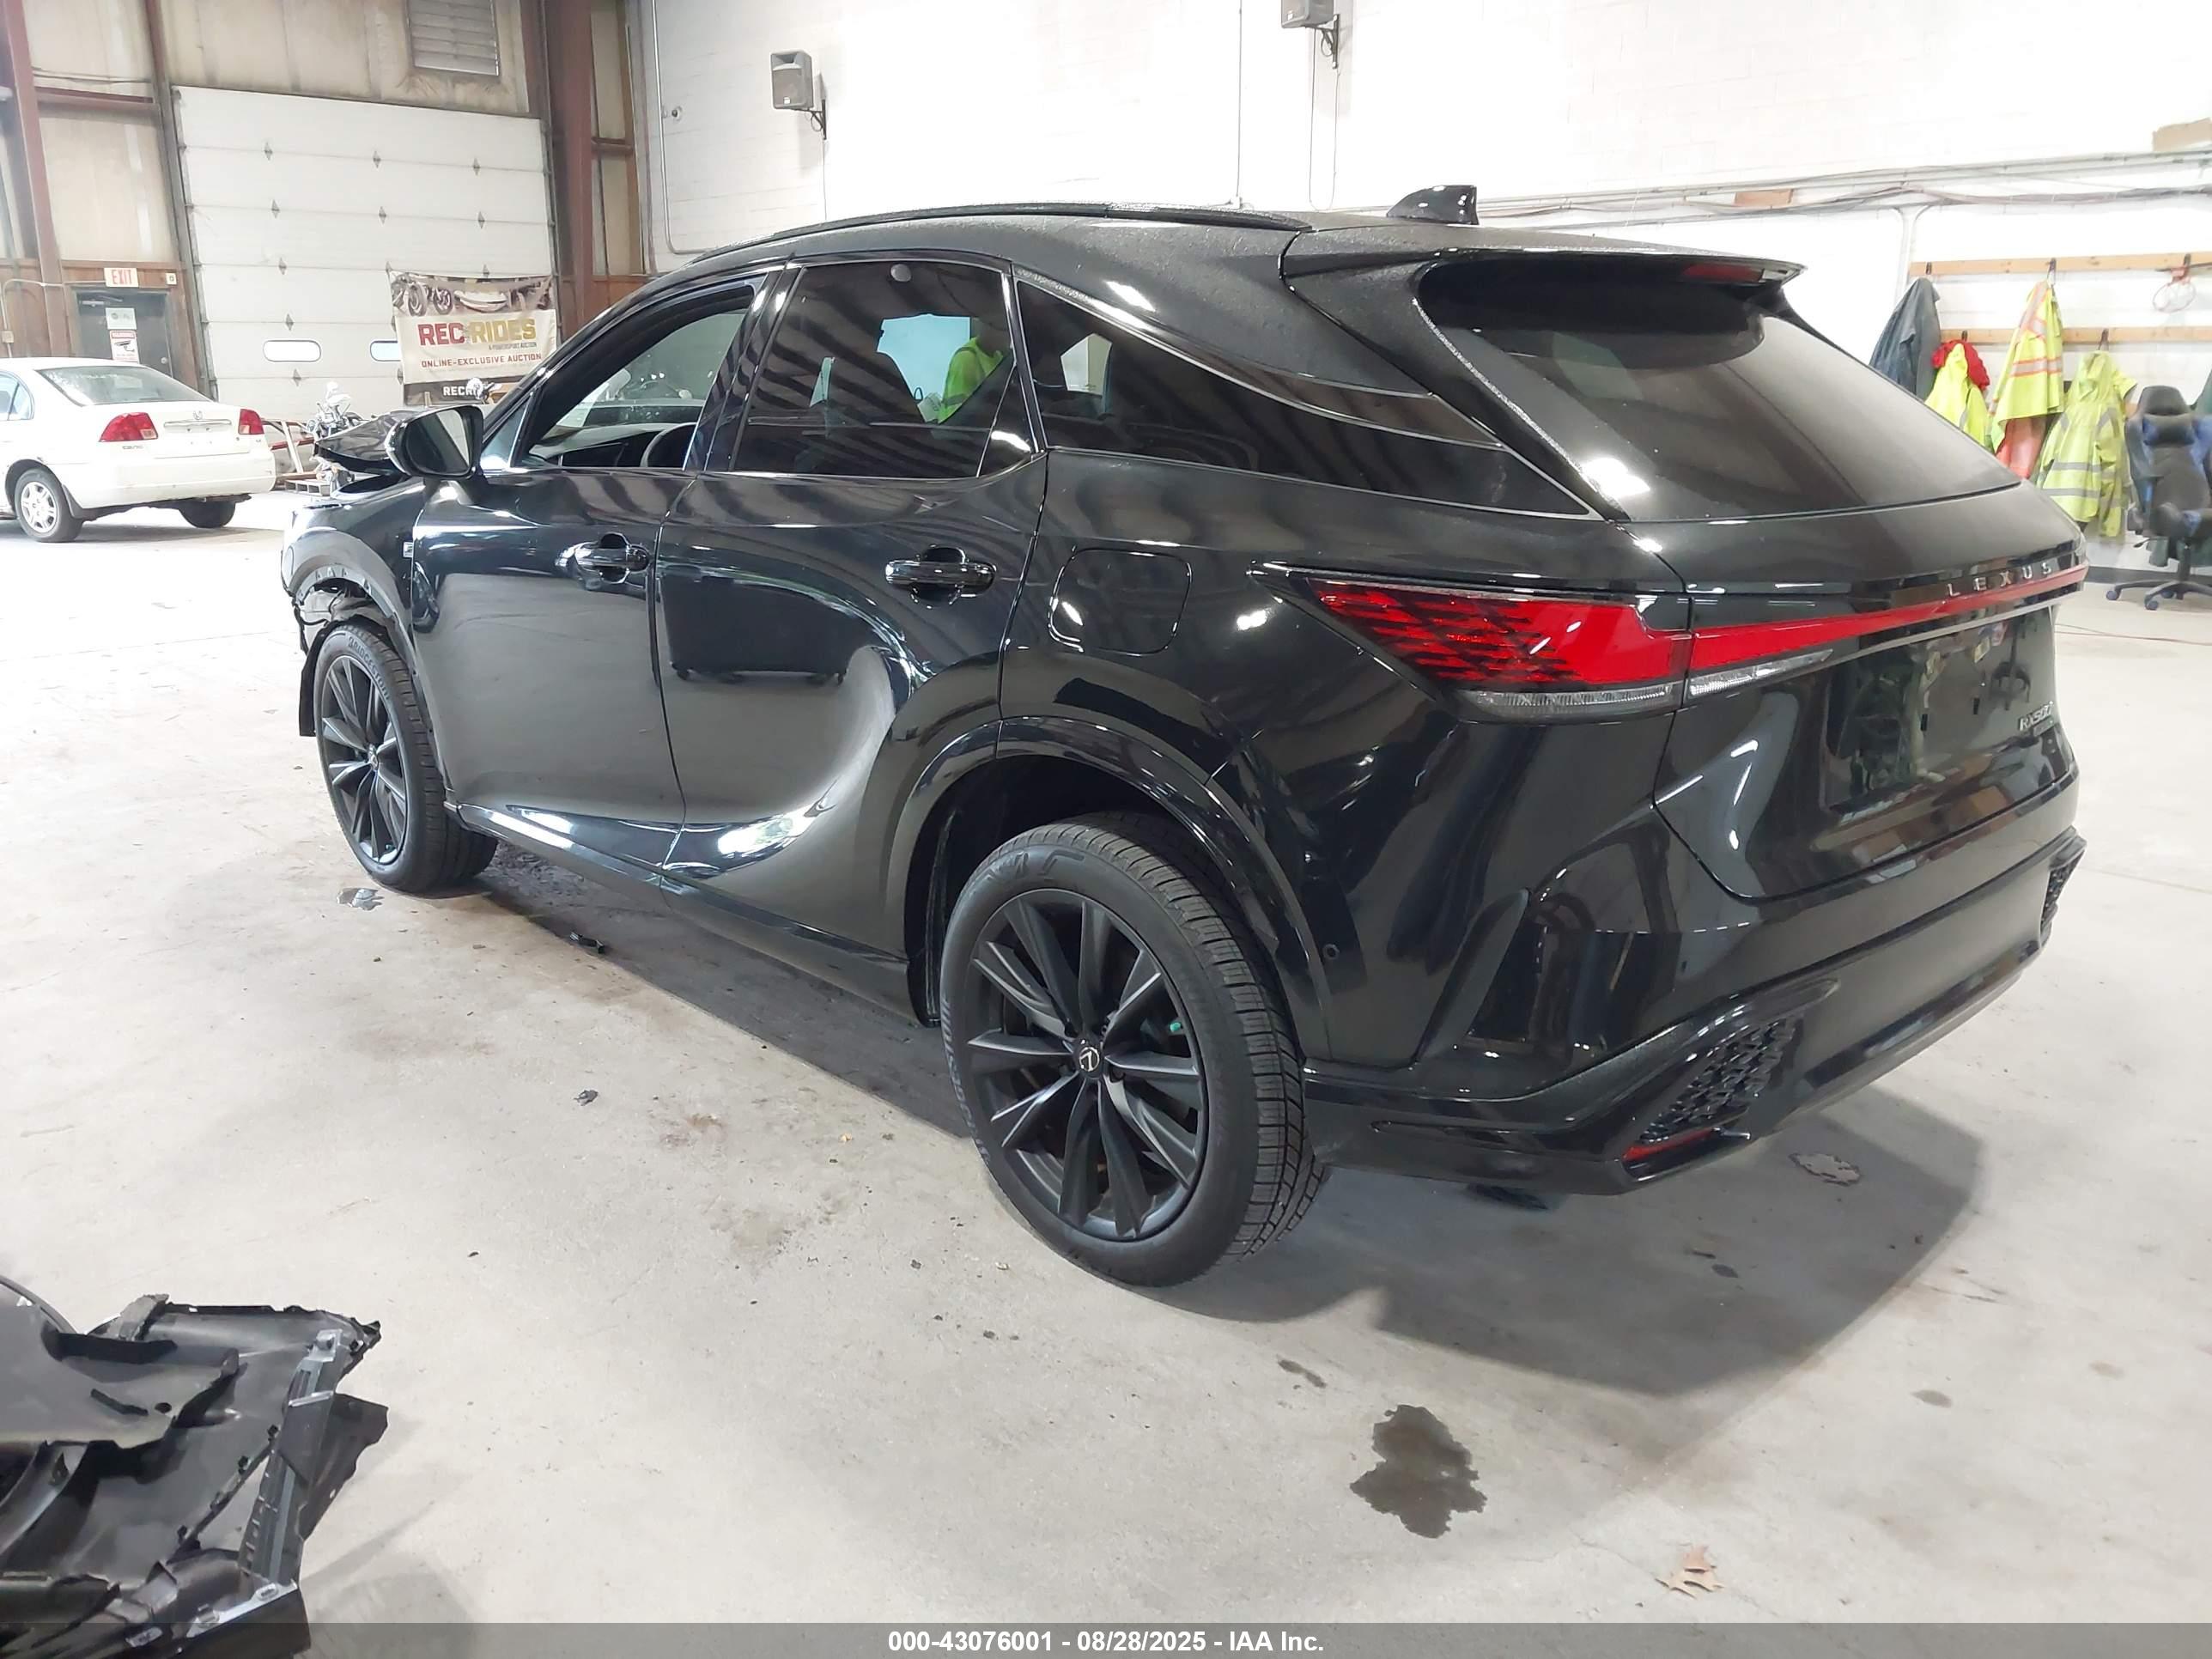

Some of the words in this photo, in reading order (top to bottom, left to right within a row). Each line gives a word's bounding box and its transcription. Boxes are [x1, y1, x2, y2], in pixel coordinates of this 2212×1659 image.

[111, 269, 133, 285] EXIT
[417, 322, 465, 346] REC
[470, 318, 537, 343] RIDES
[421, 356, 505, 368] ONLINE-EXCLUSIVE
[507, 352, 542, 362] AUCTION
[1947, 562, 2052, 598] LEXUS
